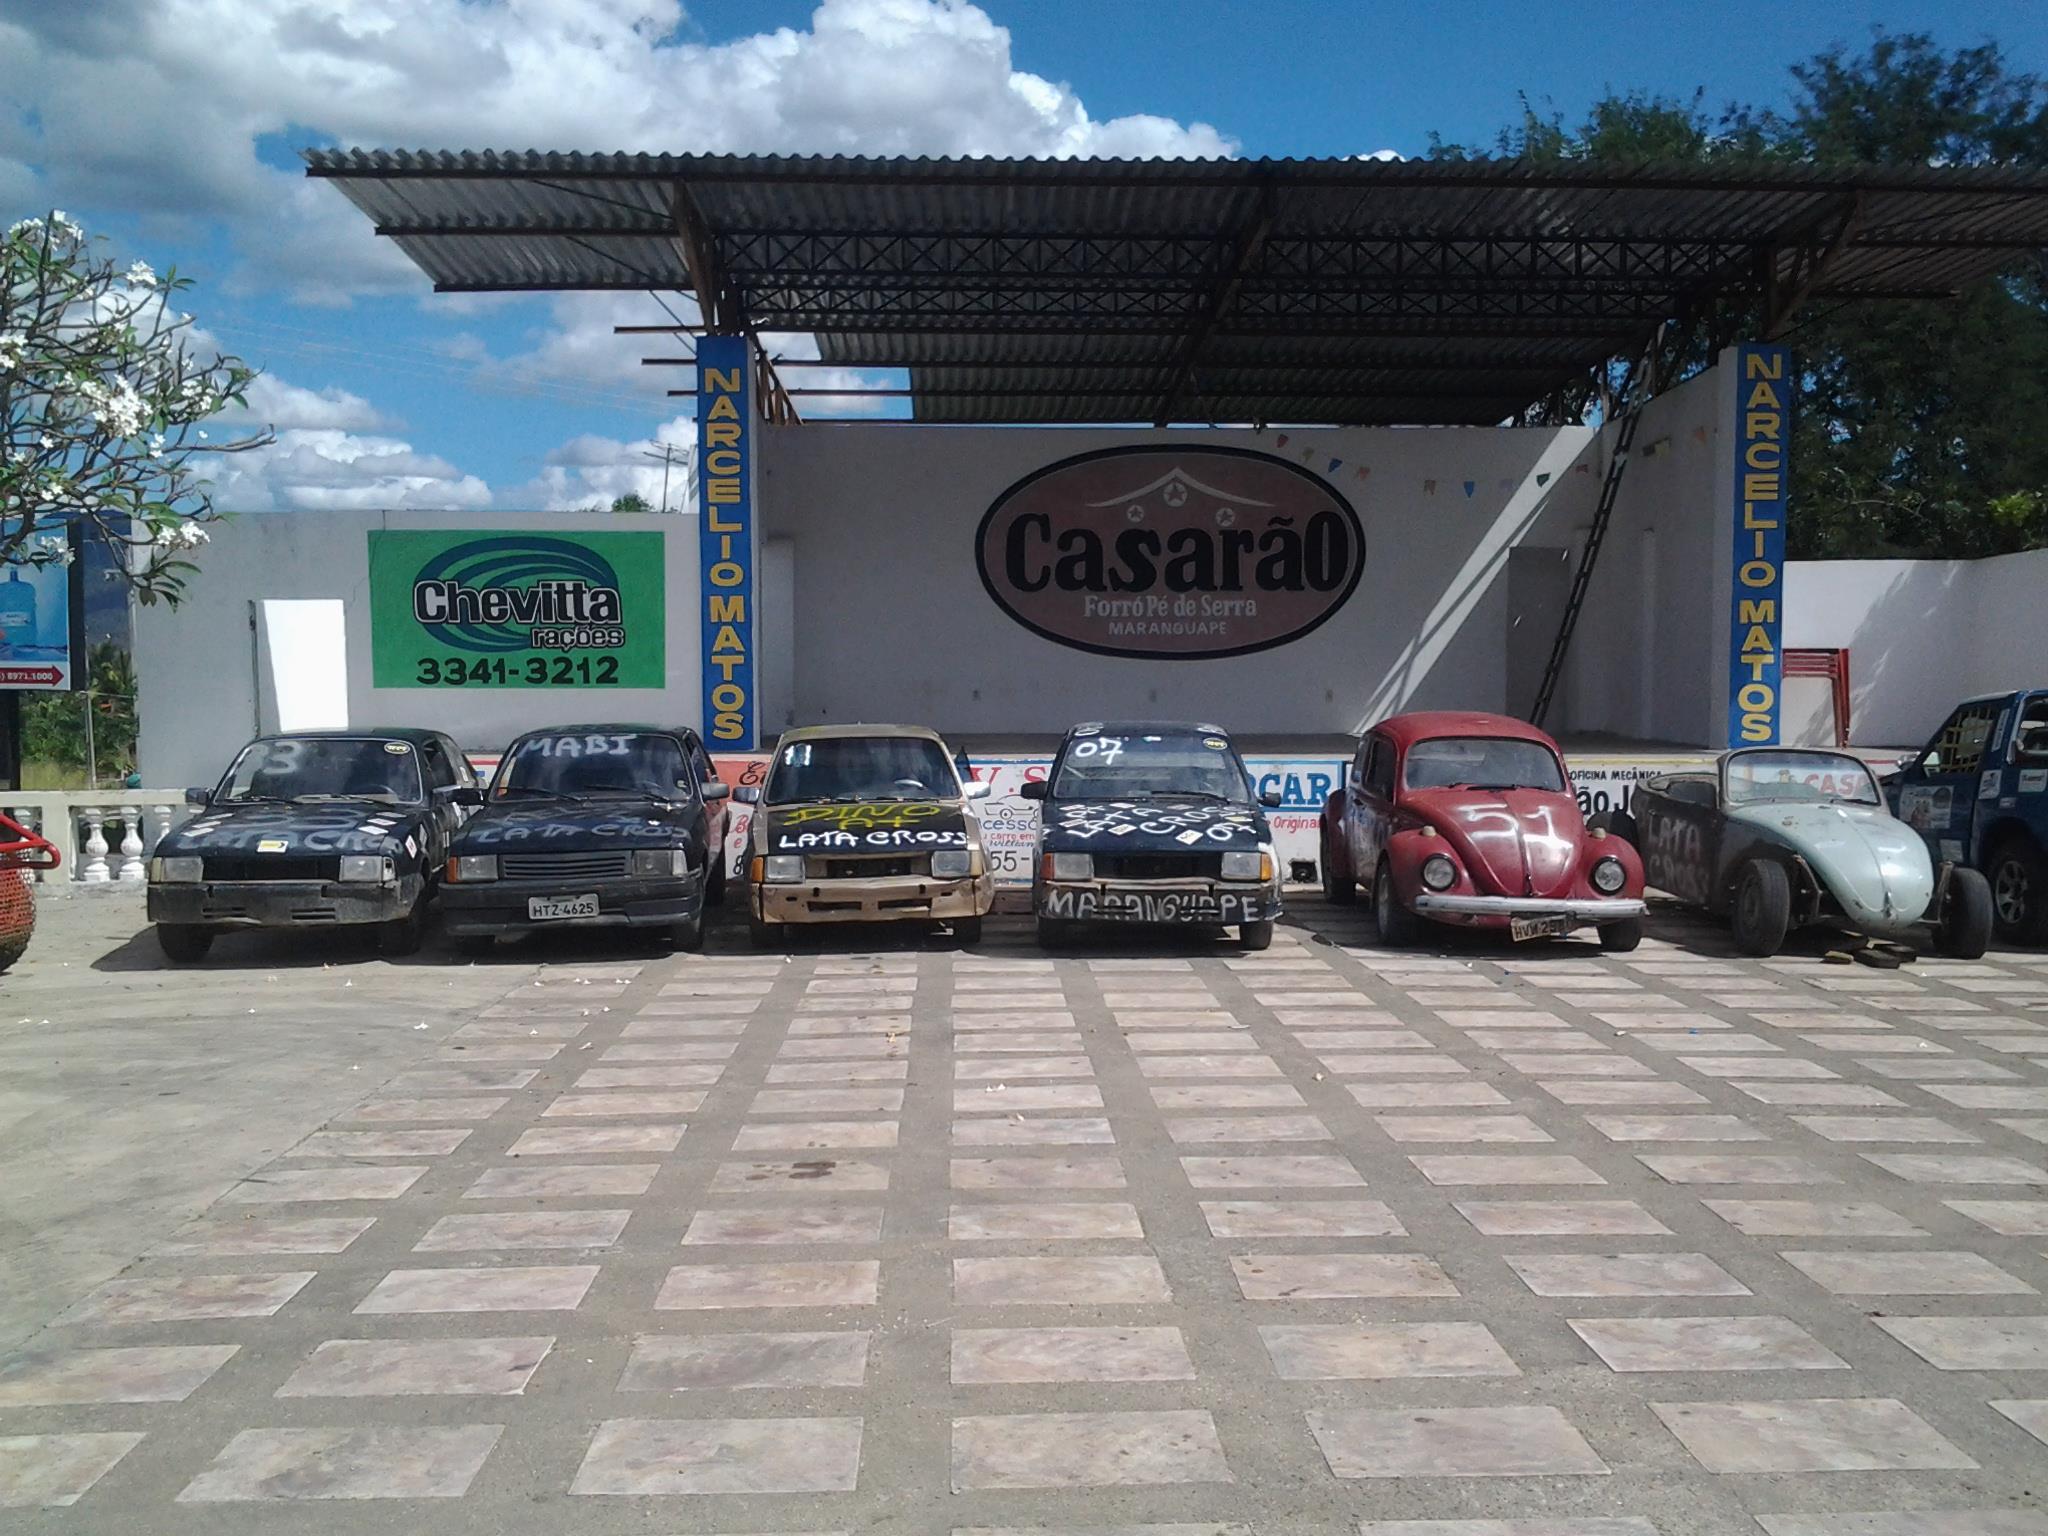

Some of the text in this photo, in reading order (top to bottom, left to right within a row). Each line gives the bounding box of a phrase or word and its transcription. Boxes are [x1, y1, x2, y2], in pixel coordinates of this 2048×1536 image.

[704, 367, 746, 740] NARCELIO MATOS
[1737, 353, 1783, 742] NARCELIO MATOS
[413, 579, 623, 625] Chevitta
[1083, 593, 1257, 618] Forró Pé de Serra
[530, 625, 626, 653] rações
[1108, 620, 1228, 637] MARANGUAPE
[416, 656, 619, 685] 3341-3212
[517, 733, 638, 758] MABI
[1074, 737, 1123, 766] 07
[783, 804, 941, 826] DINO
[778, 830, 861, 849] LATA
[865, 830, 969, 845] CROSS
